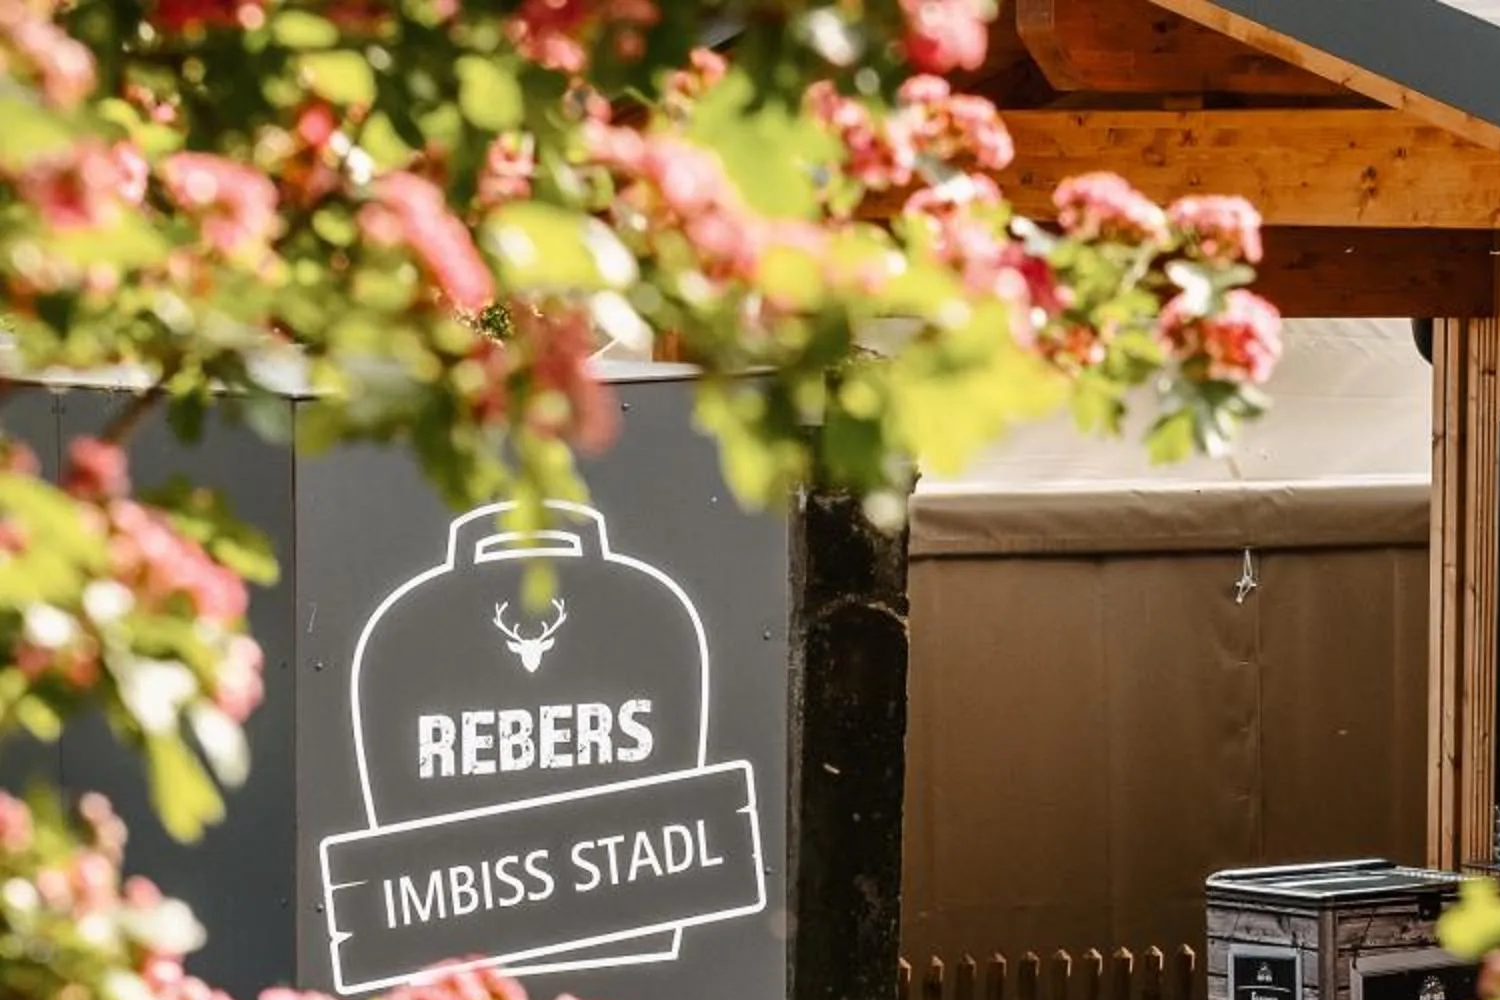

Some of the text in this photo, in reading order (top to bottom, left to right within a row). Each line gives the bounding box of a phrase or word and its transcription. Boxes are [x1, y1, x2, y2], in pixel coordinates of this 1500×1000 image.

[418, 698, 655, 780] REBERS
[383, 819, 724, 929] IMBISS STADL
